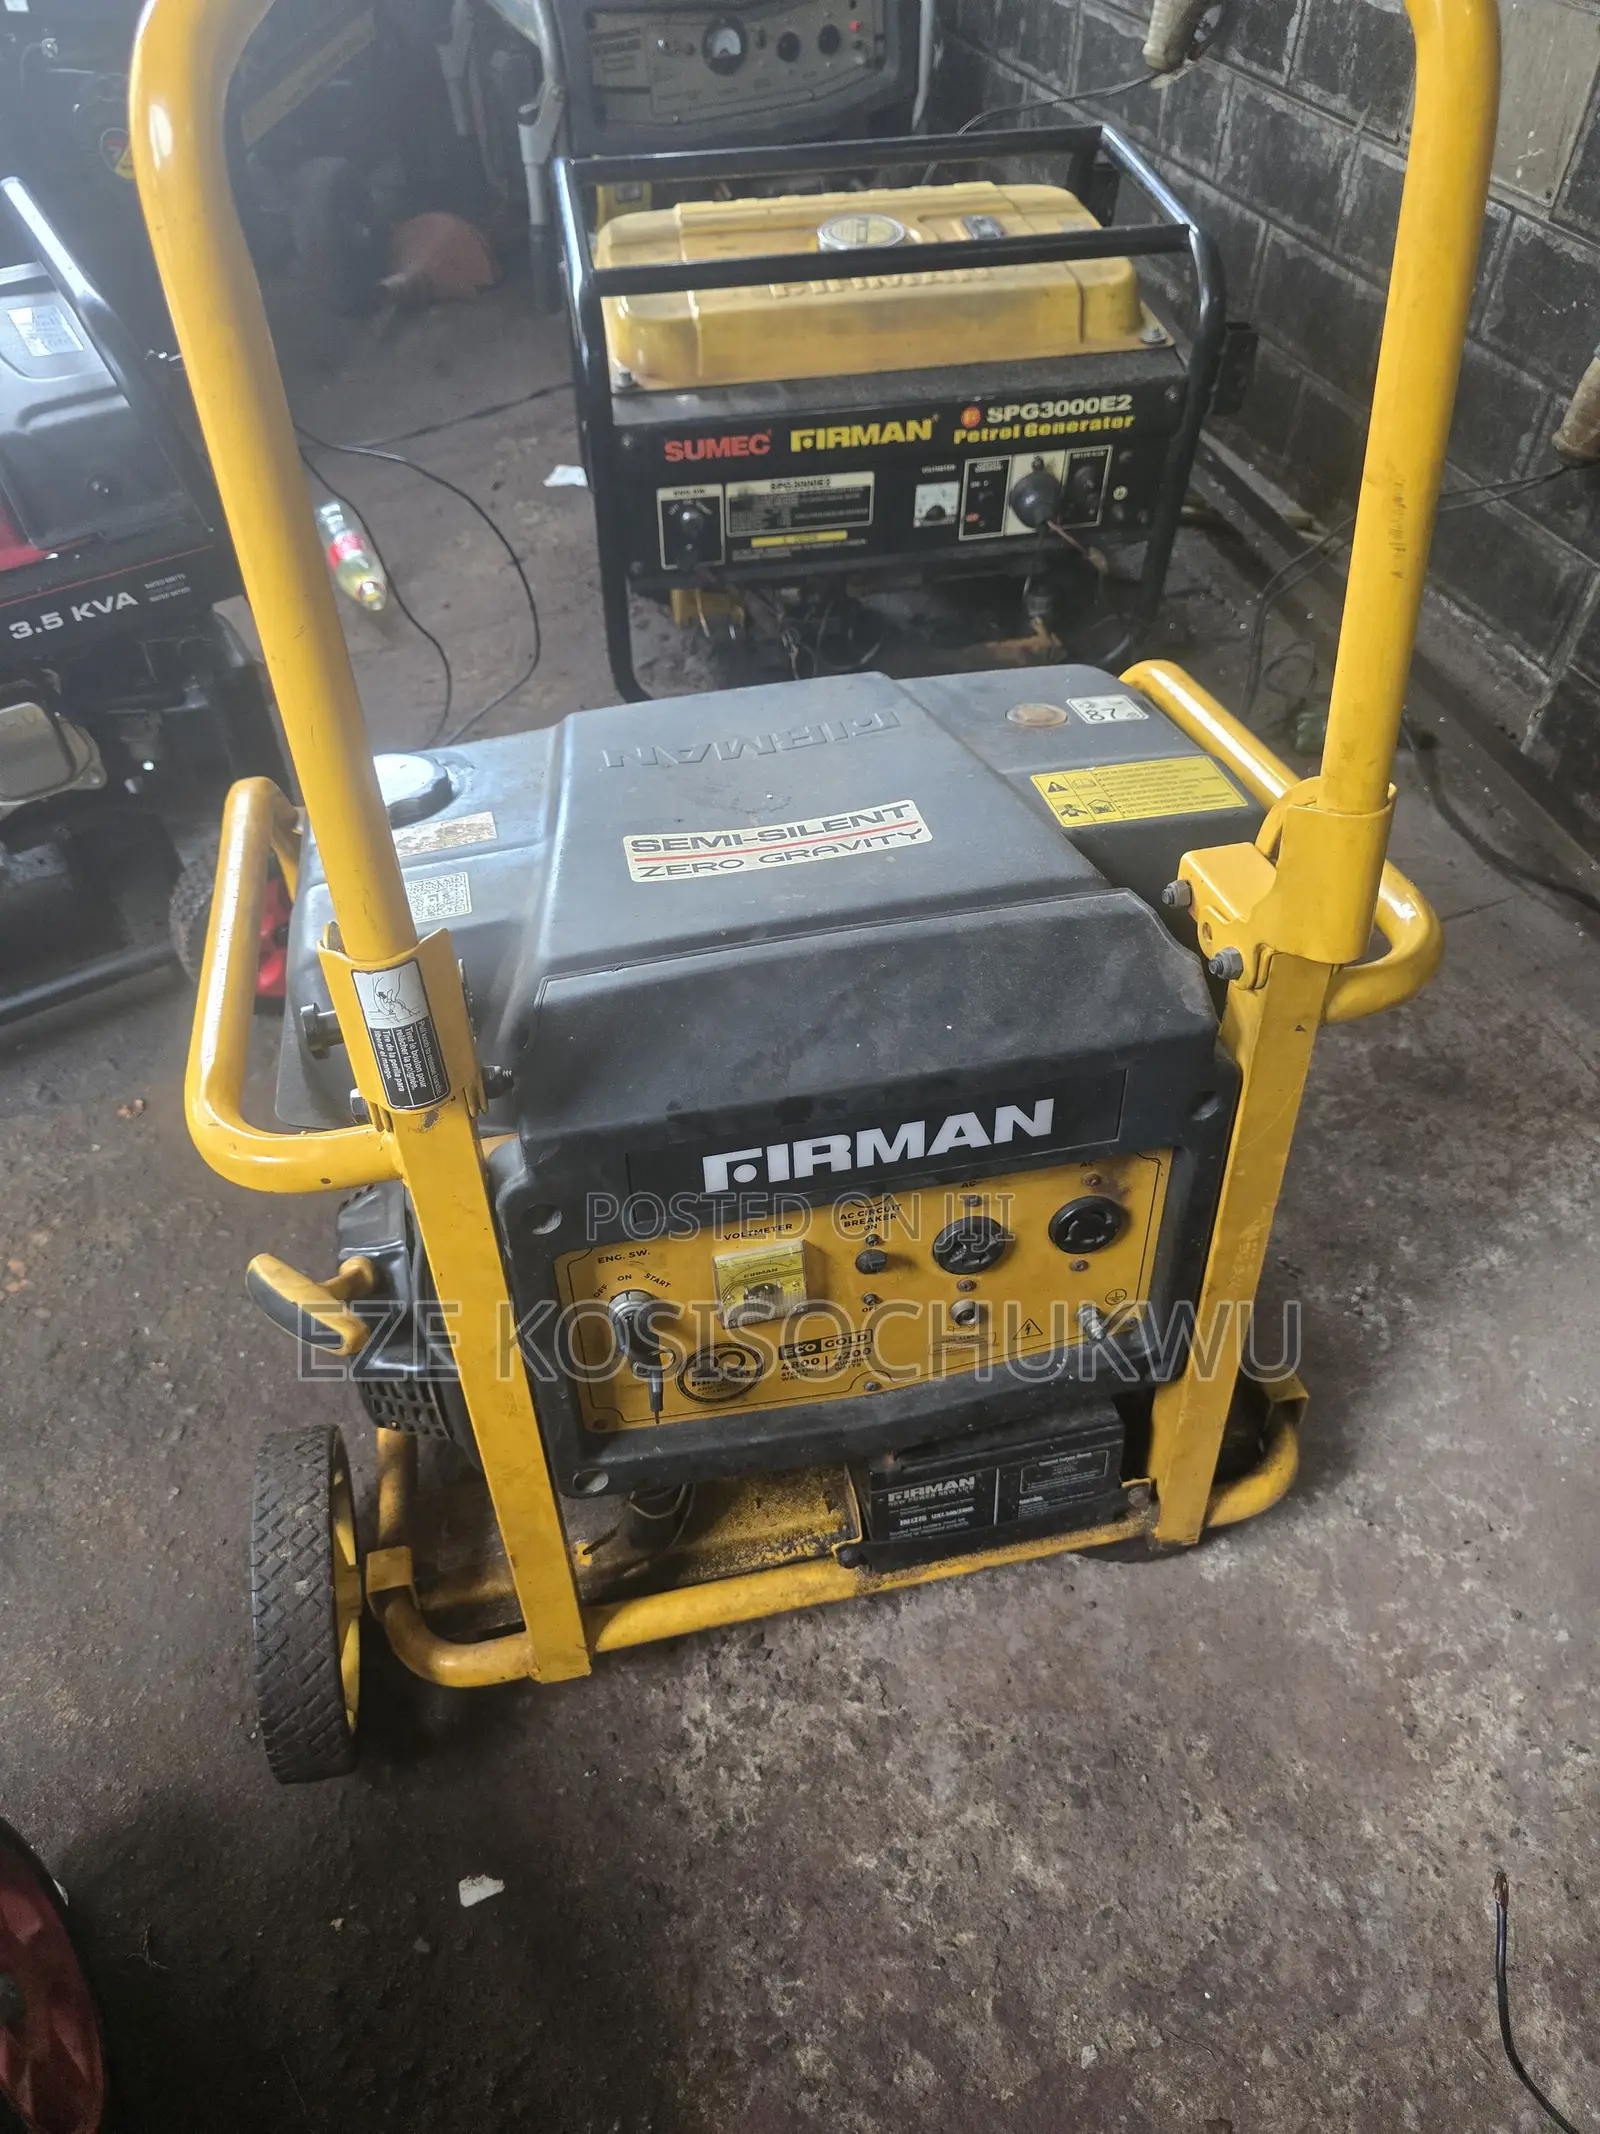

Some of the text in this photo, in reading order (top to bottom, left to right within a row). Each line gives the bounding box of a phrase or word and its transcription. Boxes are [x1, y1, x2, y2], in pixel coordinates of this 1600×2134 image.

[986, 394, 1133, 423] SPG3000E2
[790, 418, 932, 452] FIRMAN
[953, 415, 1135, 445] Petrol Generator
[665, 433, 771, 462] SUMEC
[9, 591, 139, 639] 3.5 KVA
[1085, 708, 1116, 721] 87
[631, 803, 910, 853] SEMI-SILENT
[636, 827, 922, 878] ZERO GRAVITY
[395, 1078, 404, 1092] para
[418, 1073, 427, 1088] pour
[703, 1098, 1054, 1193] FIRMAN
[844, 1213, 897, 1227] BREAKER
[723, 1223, 793, 1241] VOLTMETER
[597, 1249, 650, 1264] ENG. SW.
[617, 1274, 632, 1282] ON
[644, 1272, 672, 1289] START
[594, 1283, 609, 1299] OFF
[784, 1332, 868, 1358] ECO GOLD
[780, 1357, 821, 1371] 4800
[888, 1476, 975, 1502] FIRMAN
